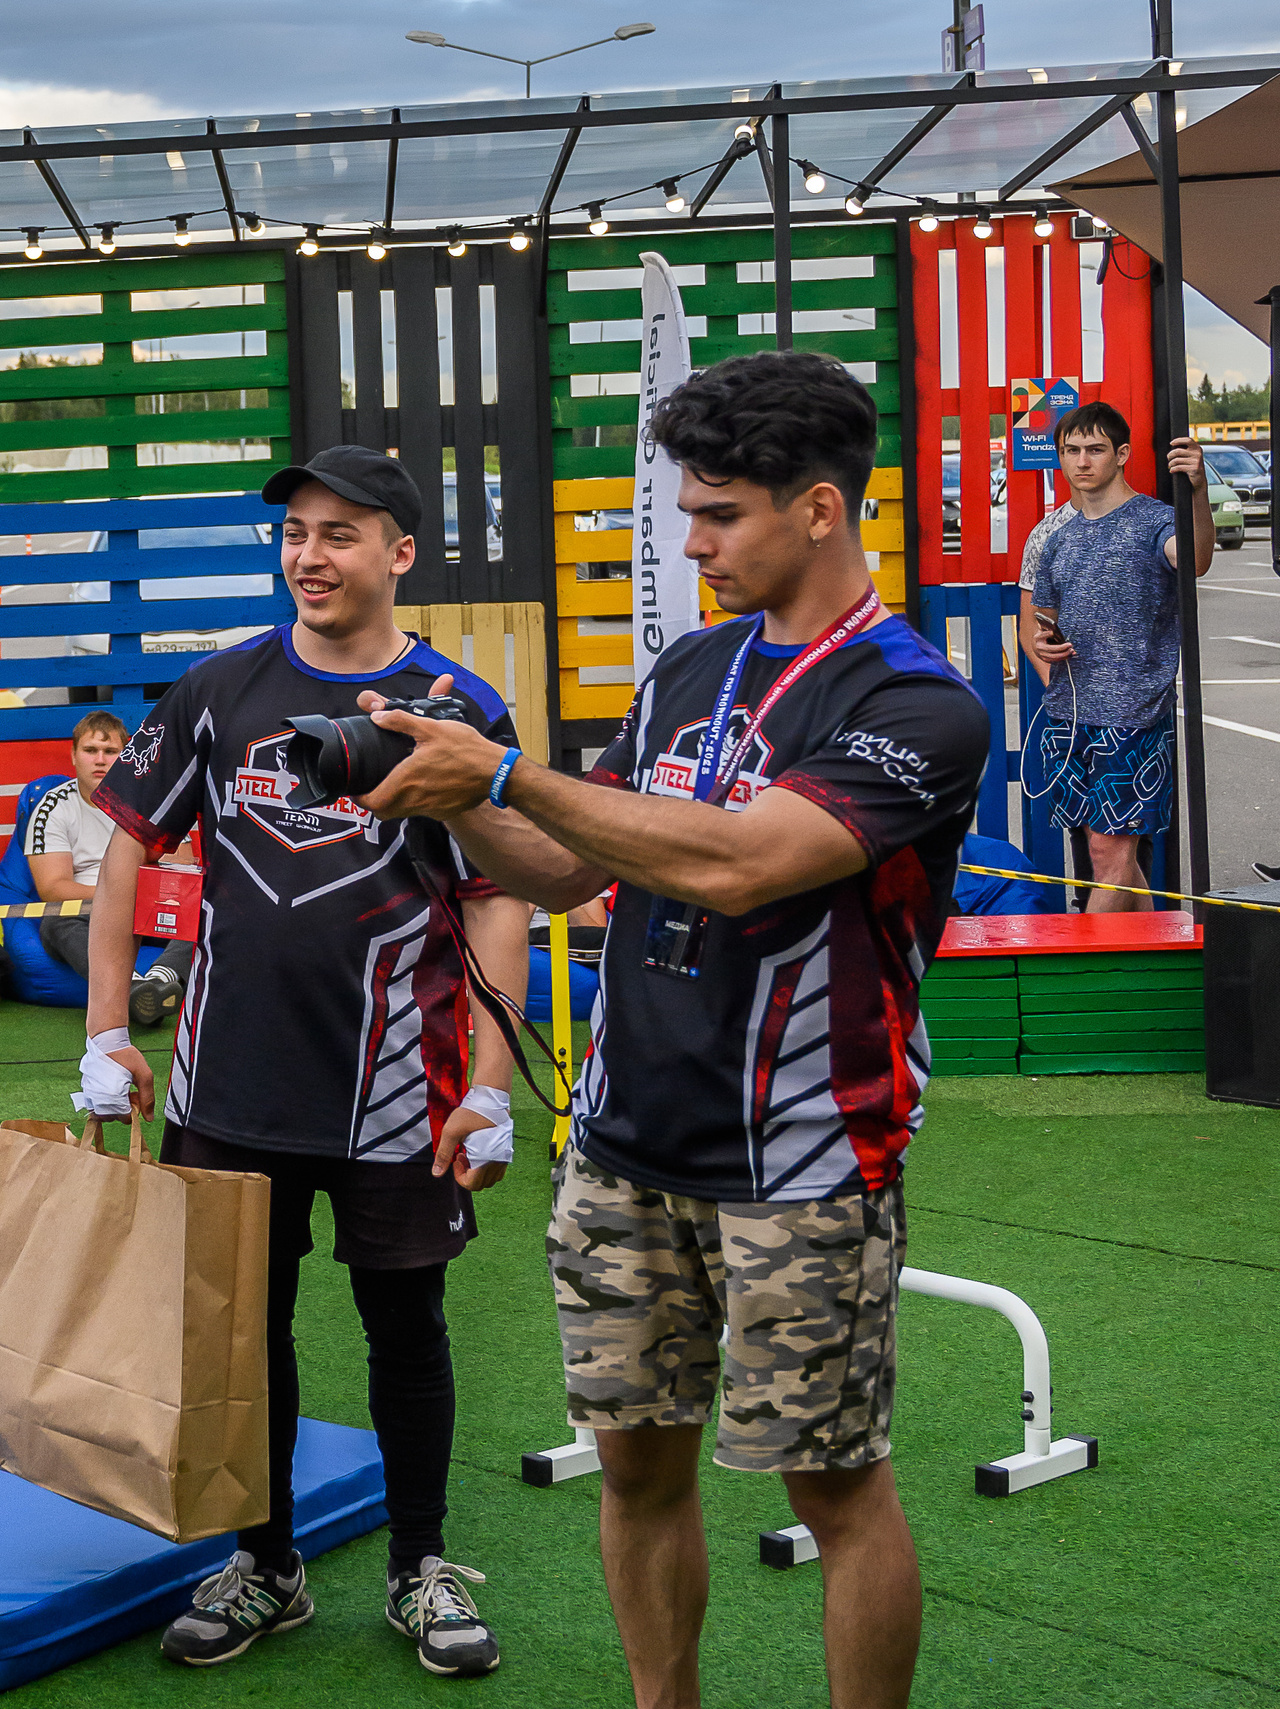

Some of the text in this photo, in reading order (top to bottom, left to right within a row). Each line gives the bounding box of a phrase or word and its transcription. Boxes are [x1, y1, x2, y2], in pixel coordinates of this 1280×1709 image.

[780, 638, 833, 687] ЧЕМПИОНАТ
[830, 628, 846, 644] ПО
[723, 677, 734, 691] ПО
[236, 774, 283, 800] STEEL
[491, 763, 511, 801] WORKOUT
[283, 810, 320, 826] TEAM
